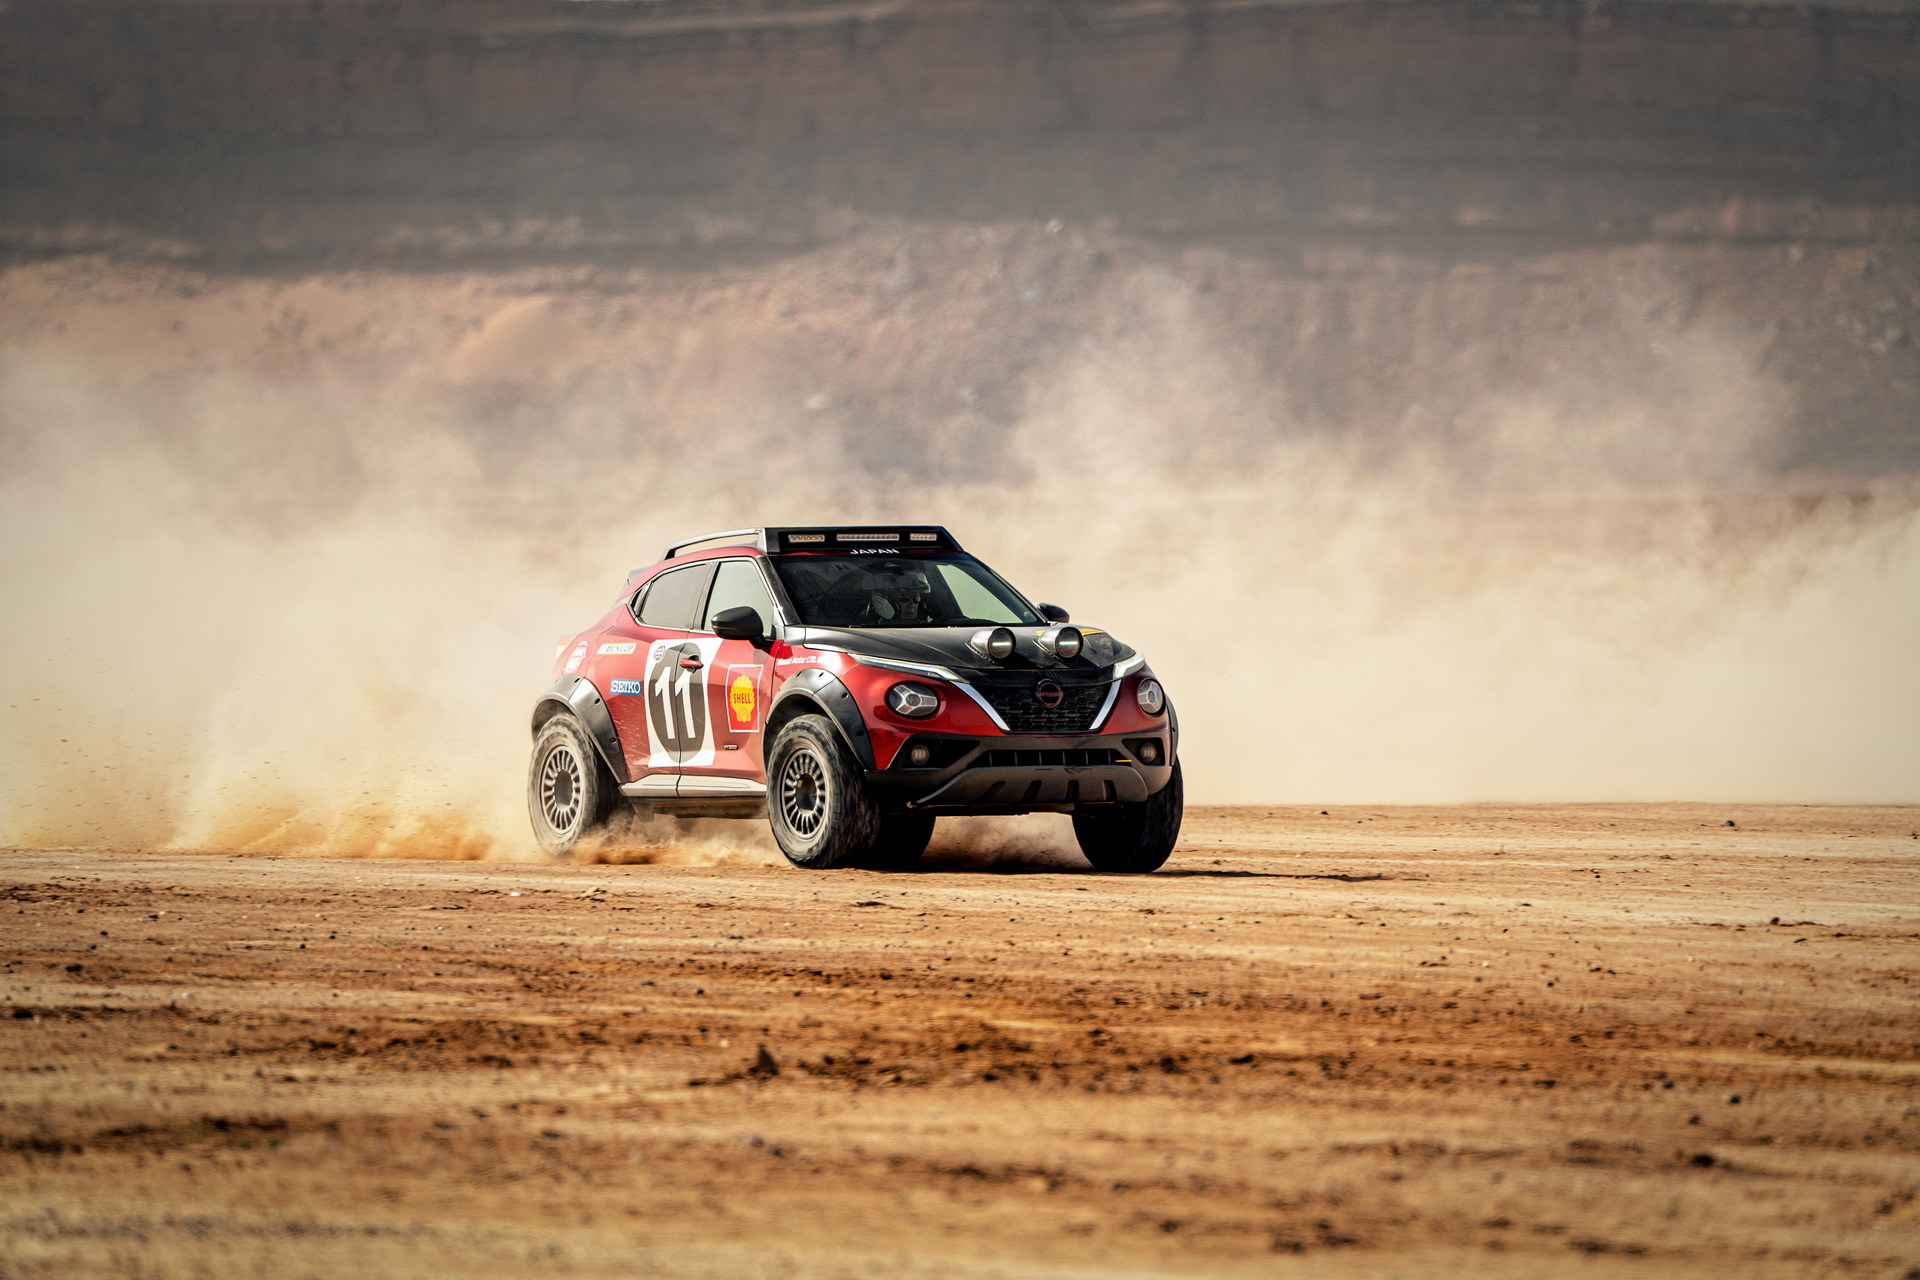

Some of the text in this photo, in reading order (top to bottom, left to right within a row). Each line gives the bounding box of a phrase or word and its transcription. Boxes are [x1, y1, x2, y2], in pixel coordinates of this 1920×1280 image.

[605, 644, 635, 653] DUNLOP
[792, 655, 806, 664] Motor
[611, 680, 641, 694] SEIKO
[654, 666, 696, 740] 11
[733, 692, 752, 704] SHELL
